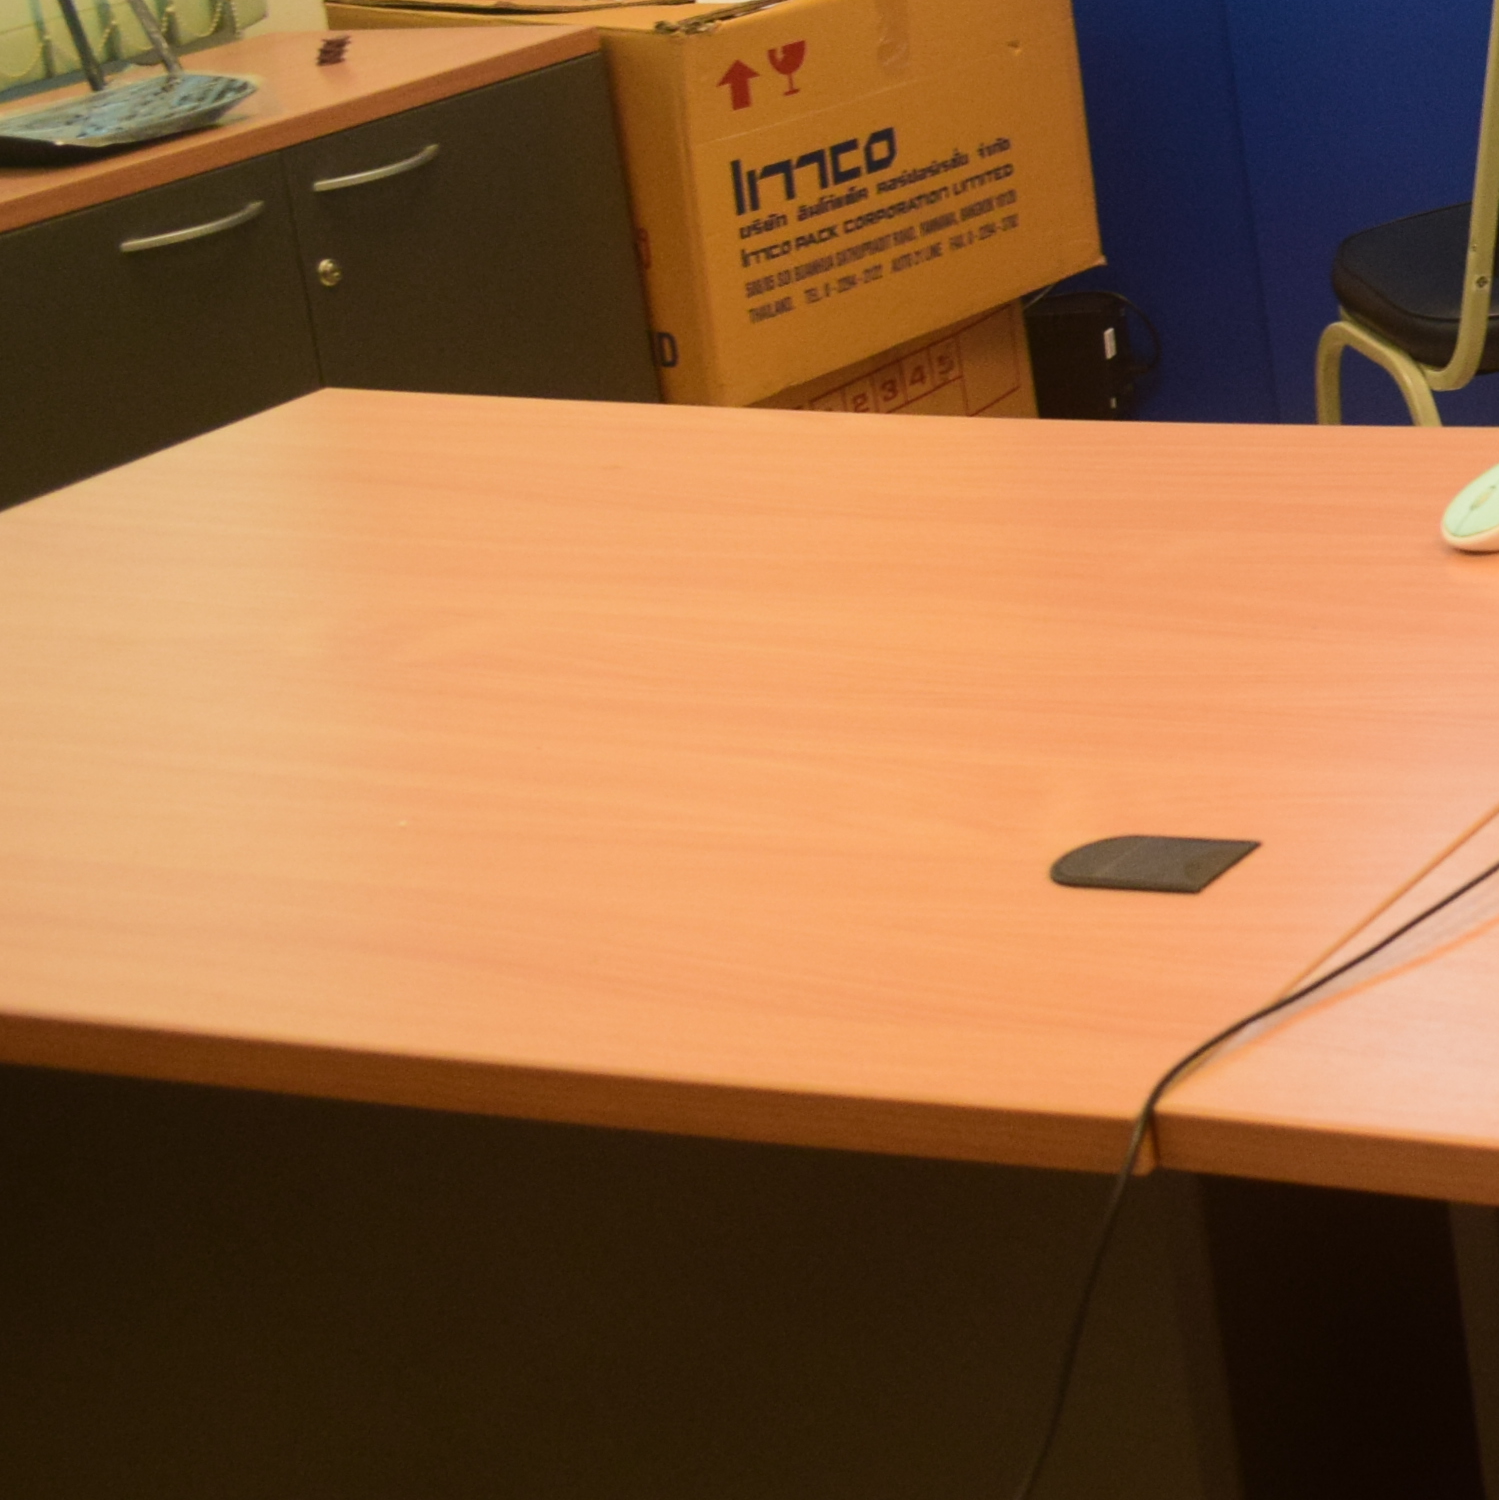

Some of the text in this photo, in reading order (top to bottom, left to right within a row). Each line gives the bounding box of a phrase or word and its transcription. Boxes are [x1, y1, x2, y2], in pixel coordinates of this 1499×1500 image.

[795, 224, 840, 250] PACK
[843, 186, 951, 235] CORPORATION
[881, 378, 899, 402] 3
[909, 364, 927, 386] 4
[935, 353, 955, 375] 5
